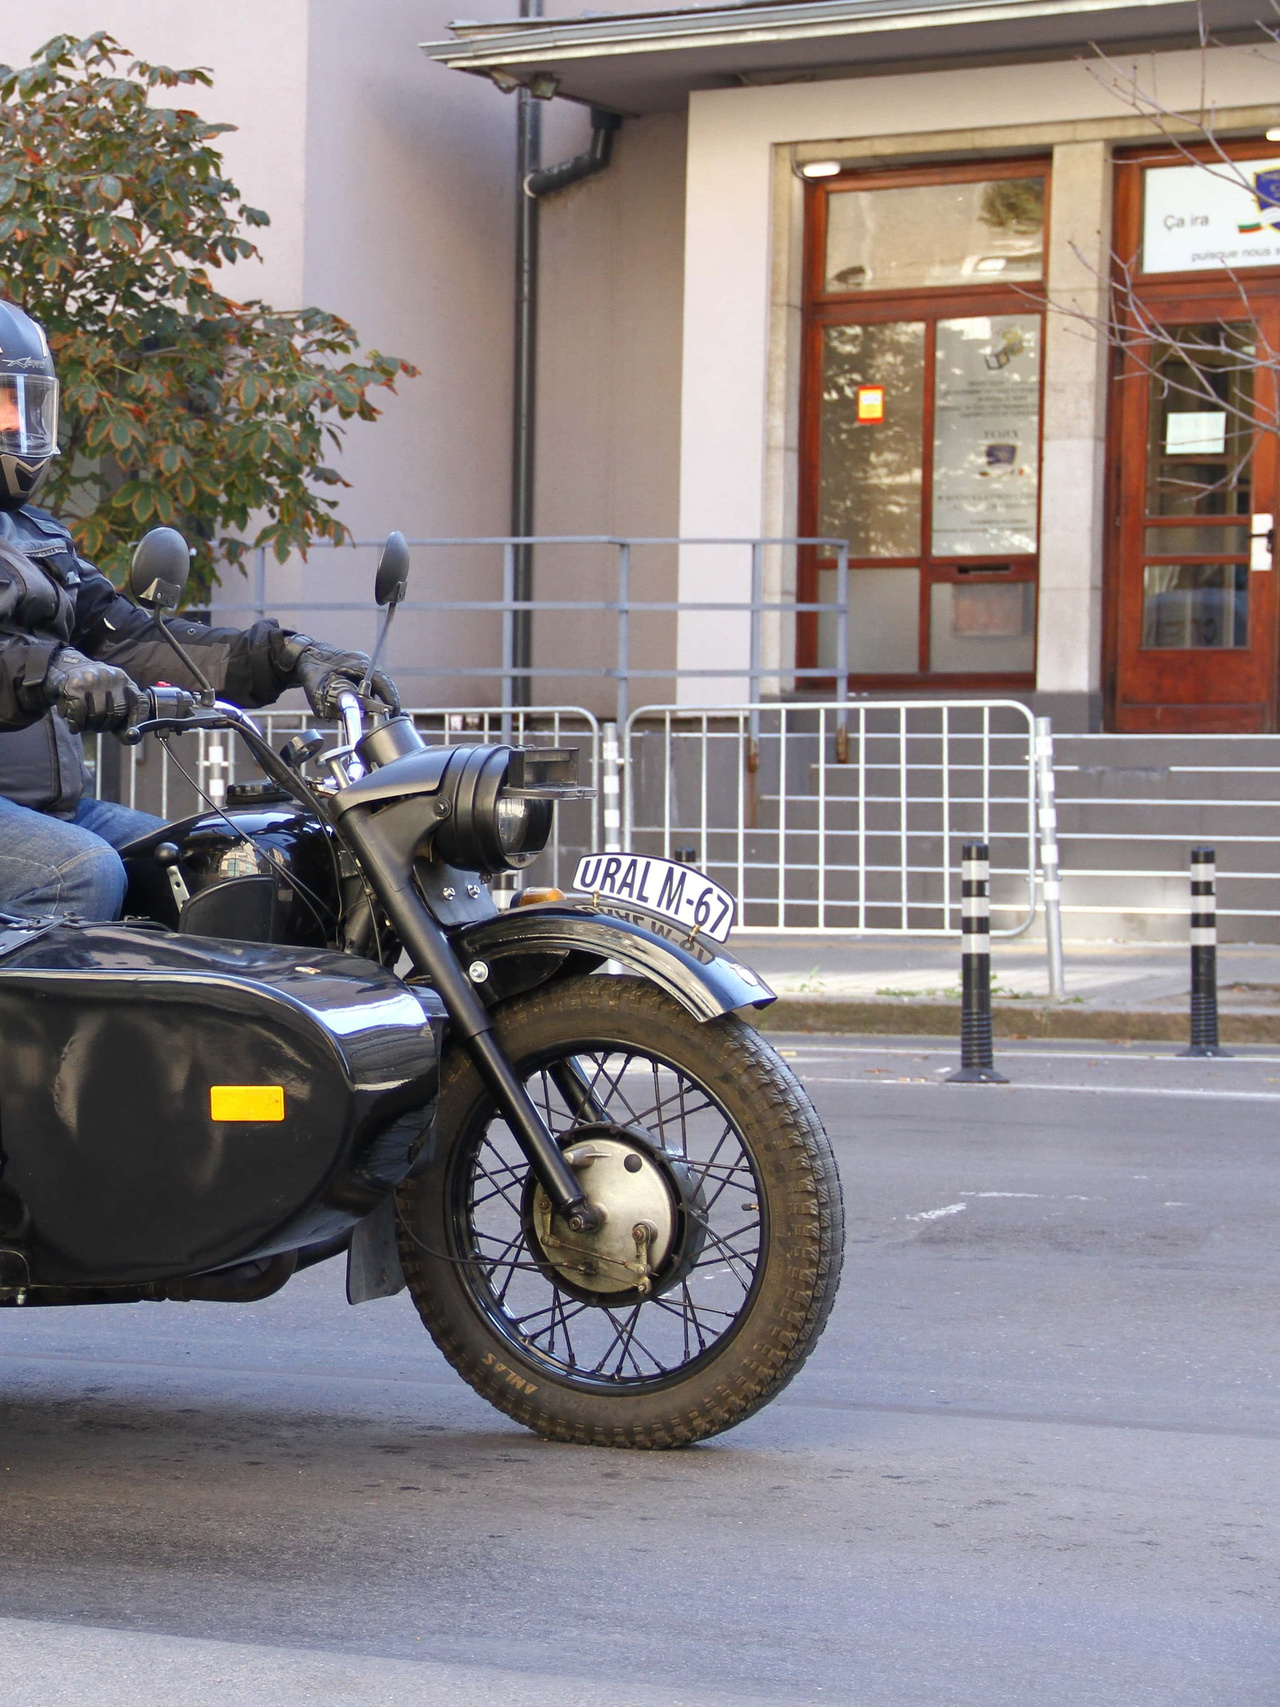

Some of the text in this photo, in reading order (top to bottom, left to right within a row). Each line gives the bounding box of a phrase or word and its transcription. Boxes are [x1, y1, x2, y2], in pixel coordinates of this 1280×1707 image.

[1163, 214, 1209, 231] Ça ira
[579, 857, 730, 934] URAL M-67
[482, 1352, 538, 1395] ANLAS
